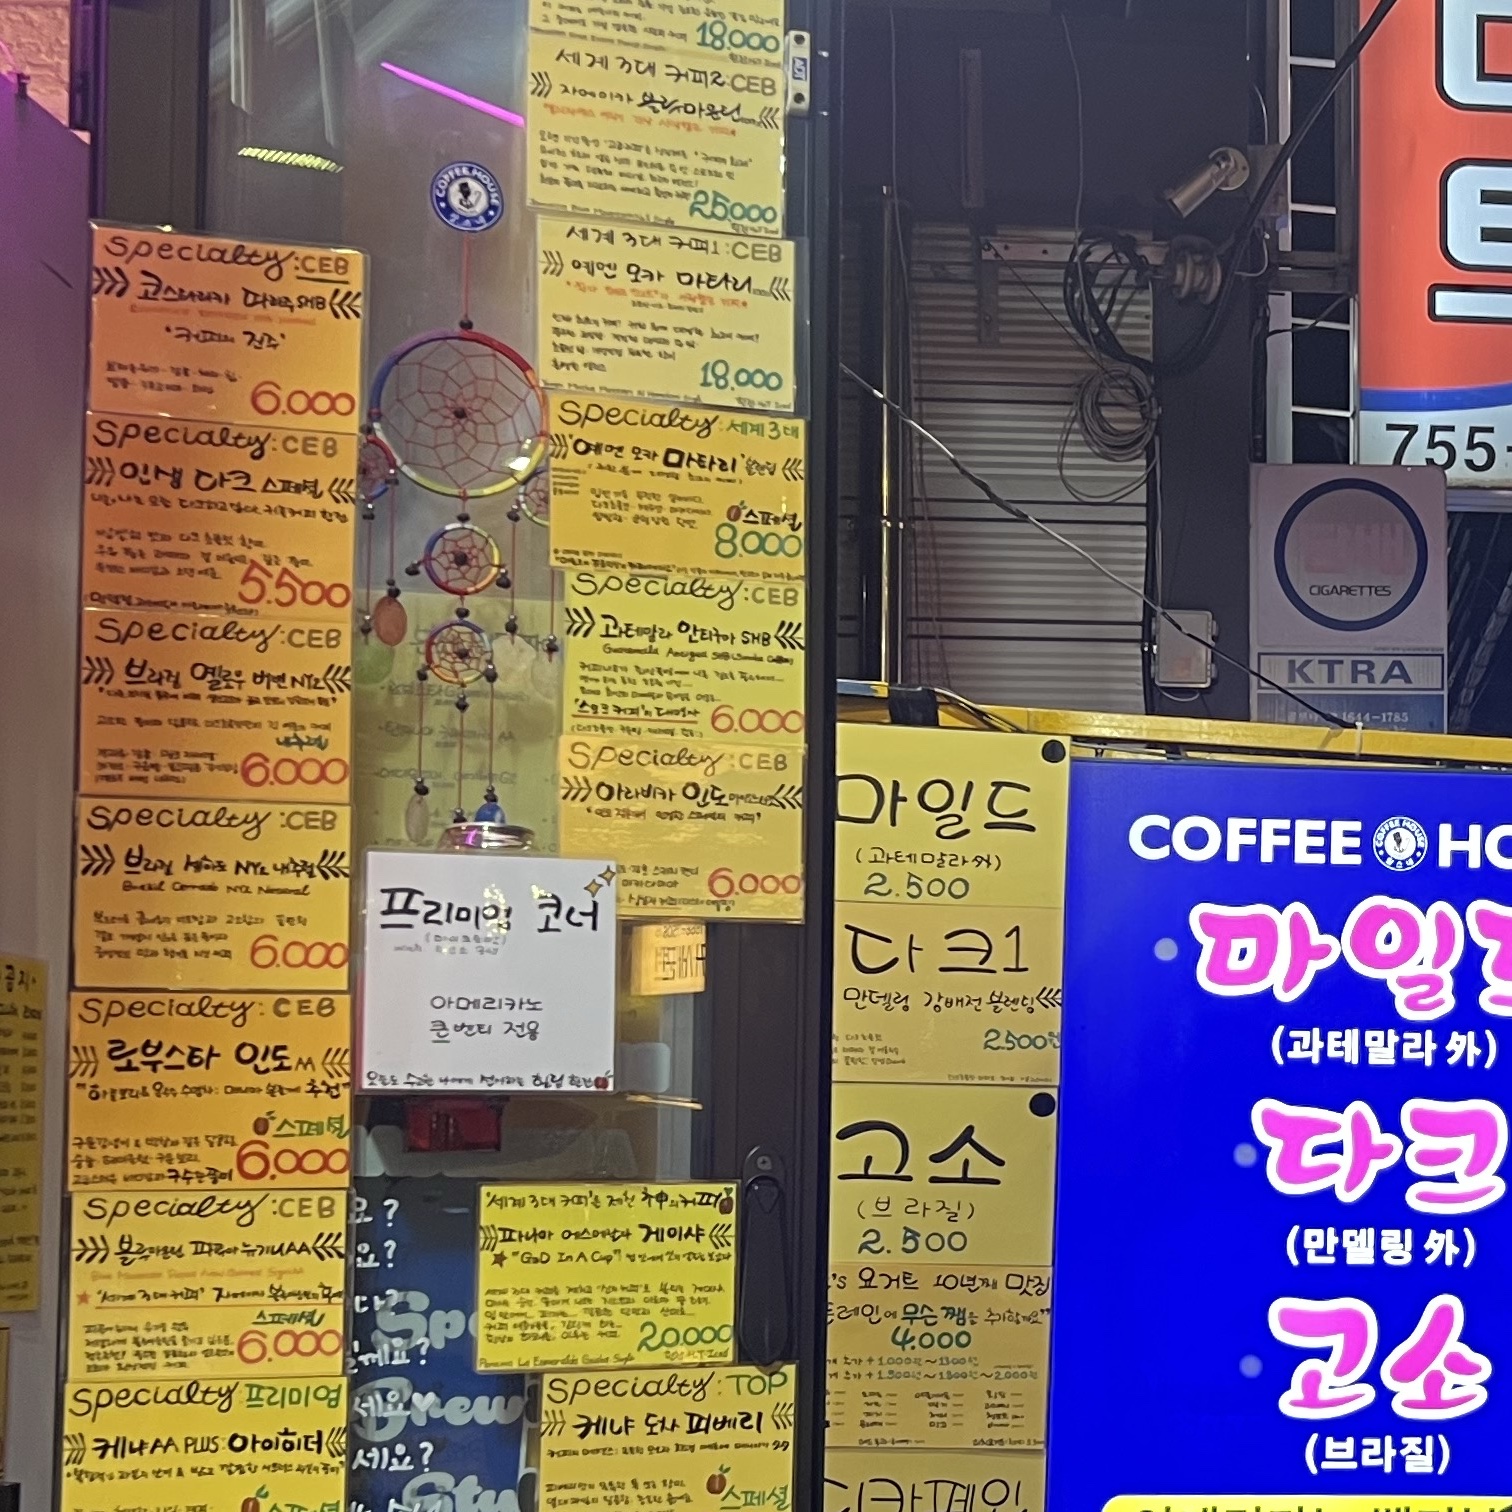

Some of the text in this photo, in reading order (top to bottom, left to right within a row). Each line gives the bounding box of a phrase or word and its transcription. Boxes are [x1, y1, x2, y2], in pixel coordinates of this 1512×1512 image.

[696, 20, 780, 52] 18.000
[700, 359, 783, 392] 18.000
[251, 382, 355, 416] 6.000
[715, 522, 801, 559] 8.000
[238, 560, 352, 608] 5.500
[1309, 585, 1392, 596] CIGARETTES
[1287, 659, 1413, 684] KTRA
[711, 705, 805, 733] 6.000
[241, 752, 348, 788] 6.000
[836, 774, 1036, 840] 마일드
[1128, 814, 1362, 866] COFFEE
[708, 867, 801, 898] 6.000
[863, 872, 970, 899] 2.500
[381, 888, 599, 933] 프리미엄 코너
[251, 934, 348, 969] 6.000
[272, 998, 335, 1016] CEB
[430, 996, 543, 1012] 아메리카노
[843, 987, 1035, 1014] 만델링 강배전 블렌딩
[504, 1021, 540, 1041] 전용
[108, 1040, 220, 1071] 로부스타
[273, 1114, 350, 1138] 스페셜
[236, 1140, 350, 1180] 6.000
[835, 1119, 1006, 1185] 고소
[1251, 1097, 1508, 1214] 다크
[857, 1195, 976, 1222] (브라질)
[858, 1226, 968, 1254] 2.500
[858, 1267, 919, 1290] 요거트
[902, 1303, 938, 1326] 무슨
[237, 1329, 342, 1363] 6.000
[638, 1321, 734, 1352] 20.000
[891, 1325, 972, 1351] 4.000
[1267, 1294, 1492, 1420] 고소
[245, 1384, 342, 1408] 프리미엄
[726, 1372, 787, 1395] TOP
[685, 1412, 763, 1434] 피베리
[1303, 1432, 1451, 1474] (브라질)
[720, 1484, 790, 1509] 스페셜
